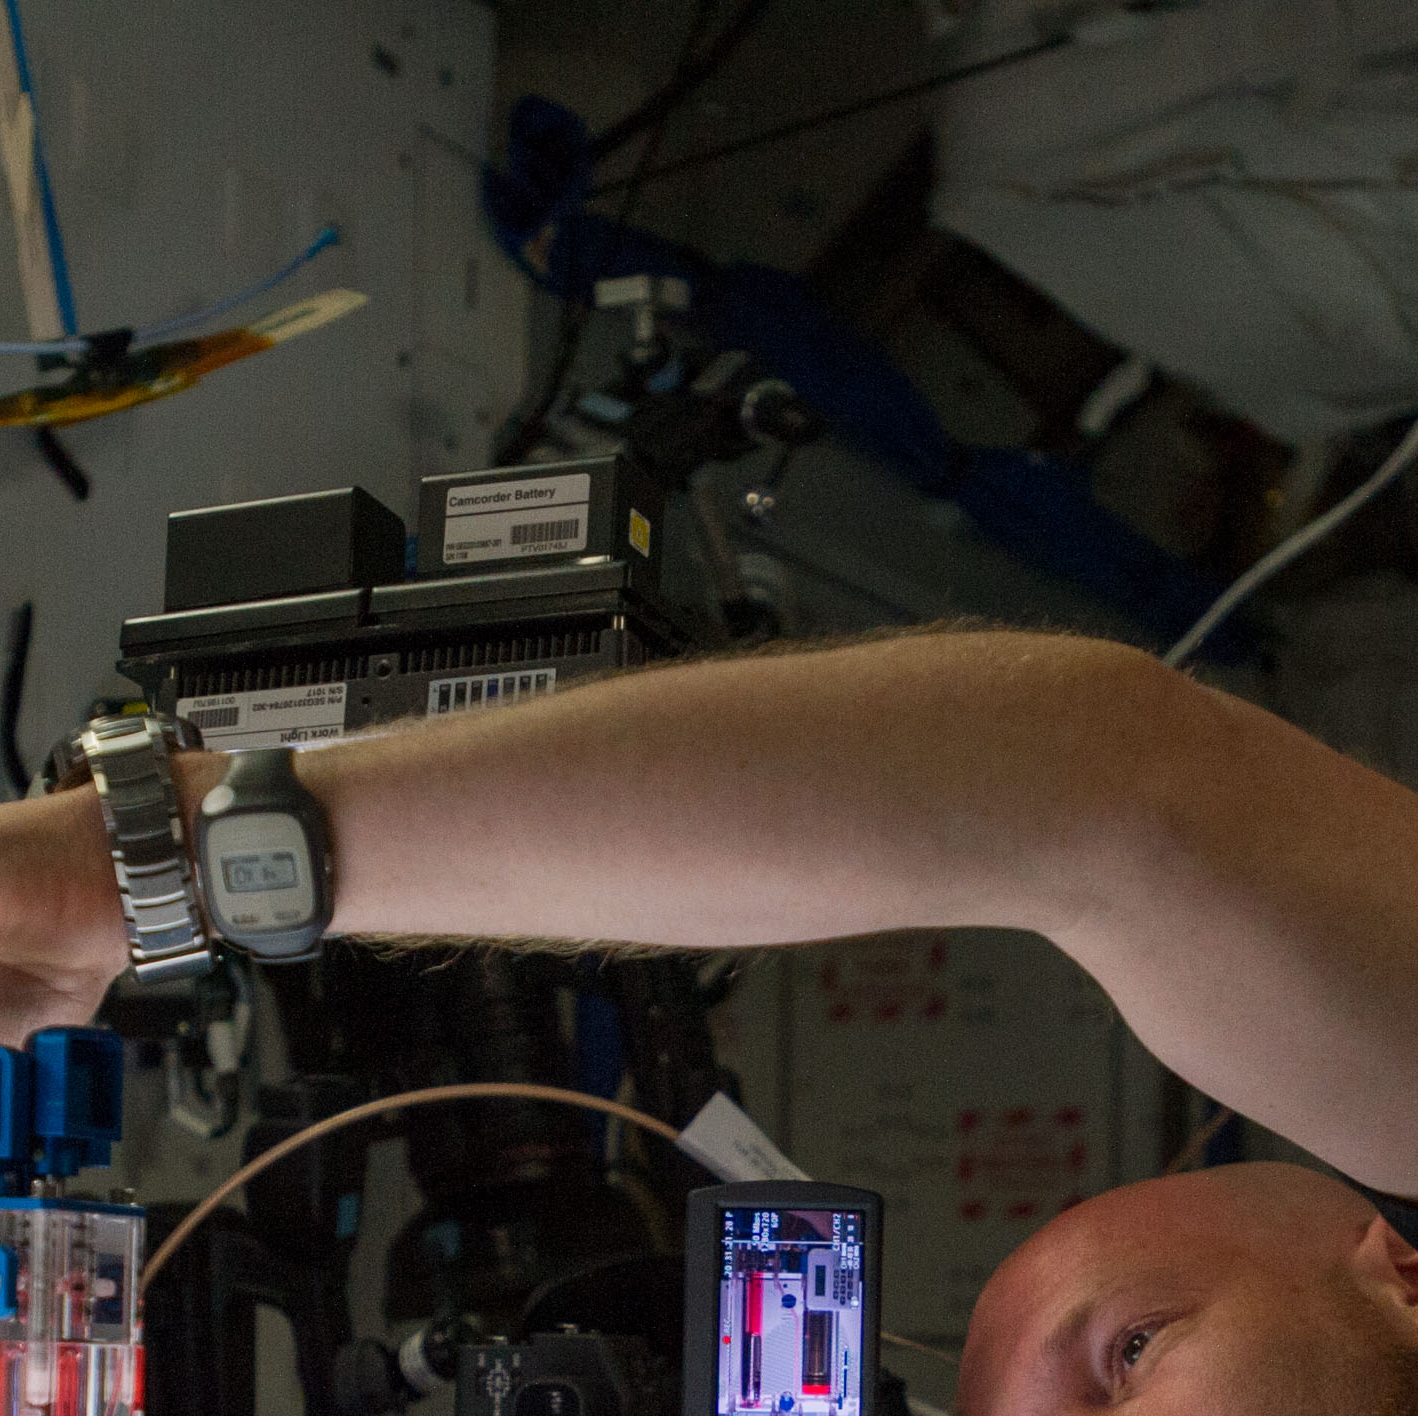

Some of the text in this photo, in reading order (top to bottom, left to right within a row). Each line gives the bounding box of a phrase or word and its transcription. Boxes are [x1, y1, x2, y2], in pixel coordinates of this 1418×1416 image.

[449, 487, 556, 507] Camcorder Battery
[330, 686, 343, 695] S/N
[329, 695, 343, 704] P/N
[281, 729, 308, 743] Light
[833, 1213, 841, 1251] CH1/CH2
